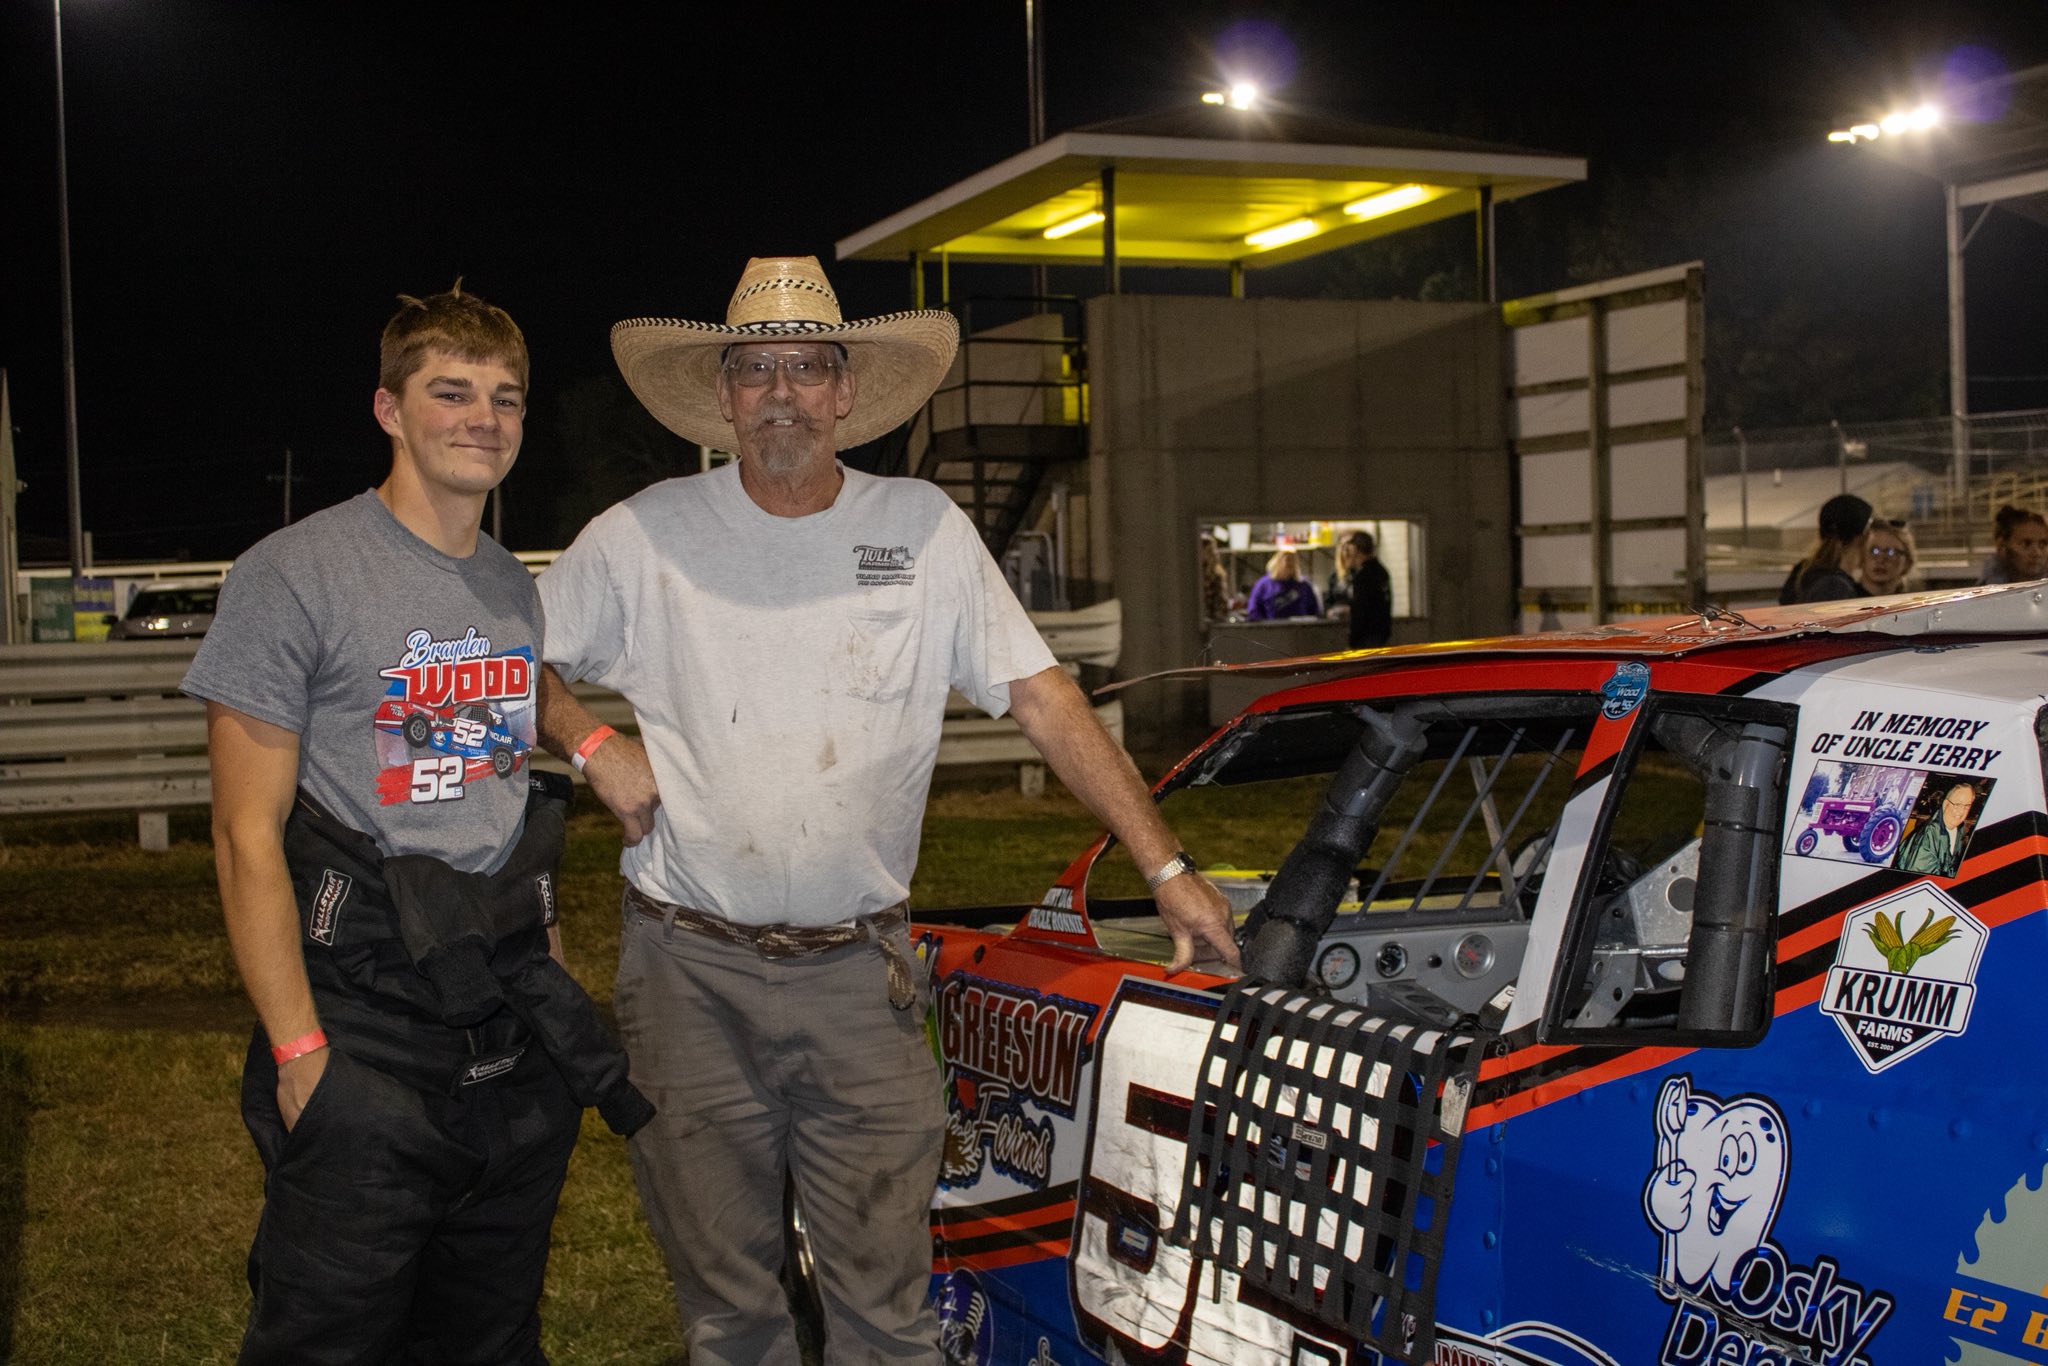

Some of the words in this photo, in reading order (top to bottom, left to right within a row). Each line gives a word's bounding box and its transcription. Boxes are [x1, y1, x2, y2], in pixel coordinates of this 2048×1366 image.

[401, 627, 490, 669] Brayden
[379, 656, 530, 707] WOOD
[452, 719, 488, 748] 52
[1850, 711, 1883, 730] IN
[1881, 714, 1990, 741] MEMORY
[1811, 733, 1844, 754] OF
[1843, 737, 1919, 762] UNCLE
[1918, 743, 2002, 771] JERRY
[411, 756, 464, 803] 52
[1834, 971, 1959, 1027] KRUMM
[942, 979, 1090, 1106] GREESON
[1856, 1020, 1914, 1044] FARMS
[1728, 1243, 1892, 1366] Osky
[1943, 1287, 2008, 1335] E2
